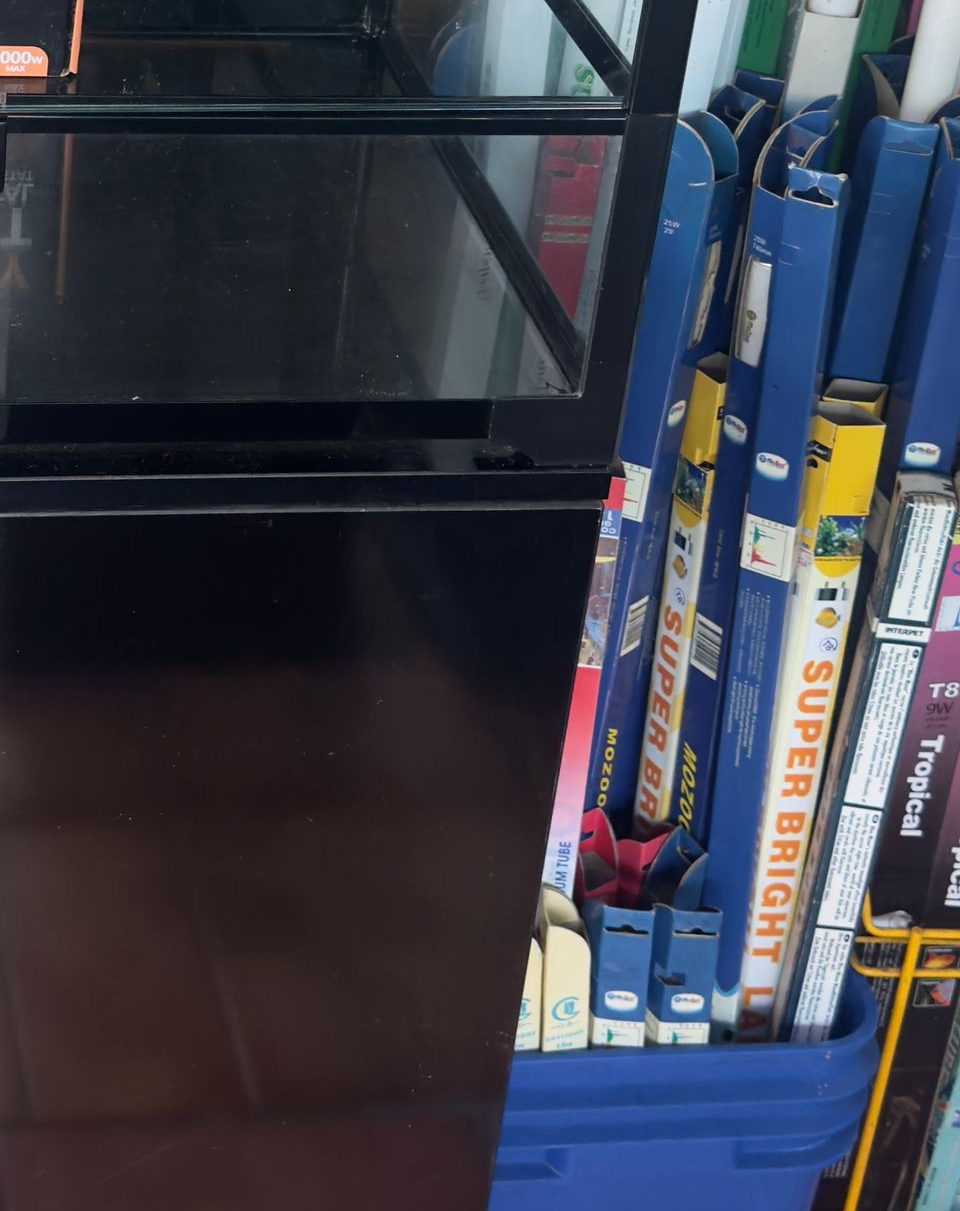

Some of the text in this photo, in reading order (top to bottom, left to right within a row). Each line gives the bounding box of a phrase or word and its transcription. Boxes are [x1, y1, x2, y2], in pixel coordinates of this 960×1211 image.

[4, 64, 27, 73] MAX
[884, 627, 924, 638] INTERPET
[648, 604, 683, 754] SUPER
[928, 682, 960, 699] T8
[597, 727, 619, 808] MOZOO
[780, 660, 834, 798] SUPER
[900, 735, 946, 837] Tropical
[559, 841, 572, 869] TUBE
[751, 811, 807, 964] BRIGHT
